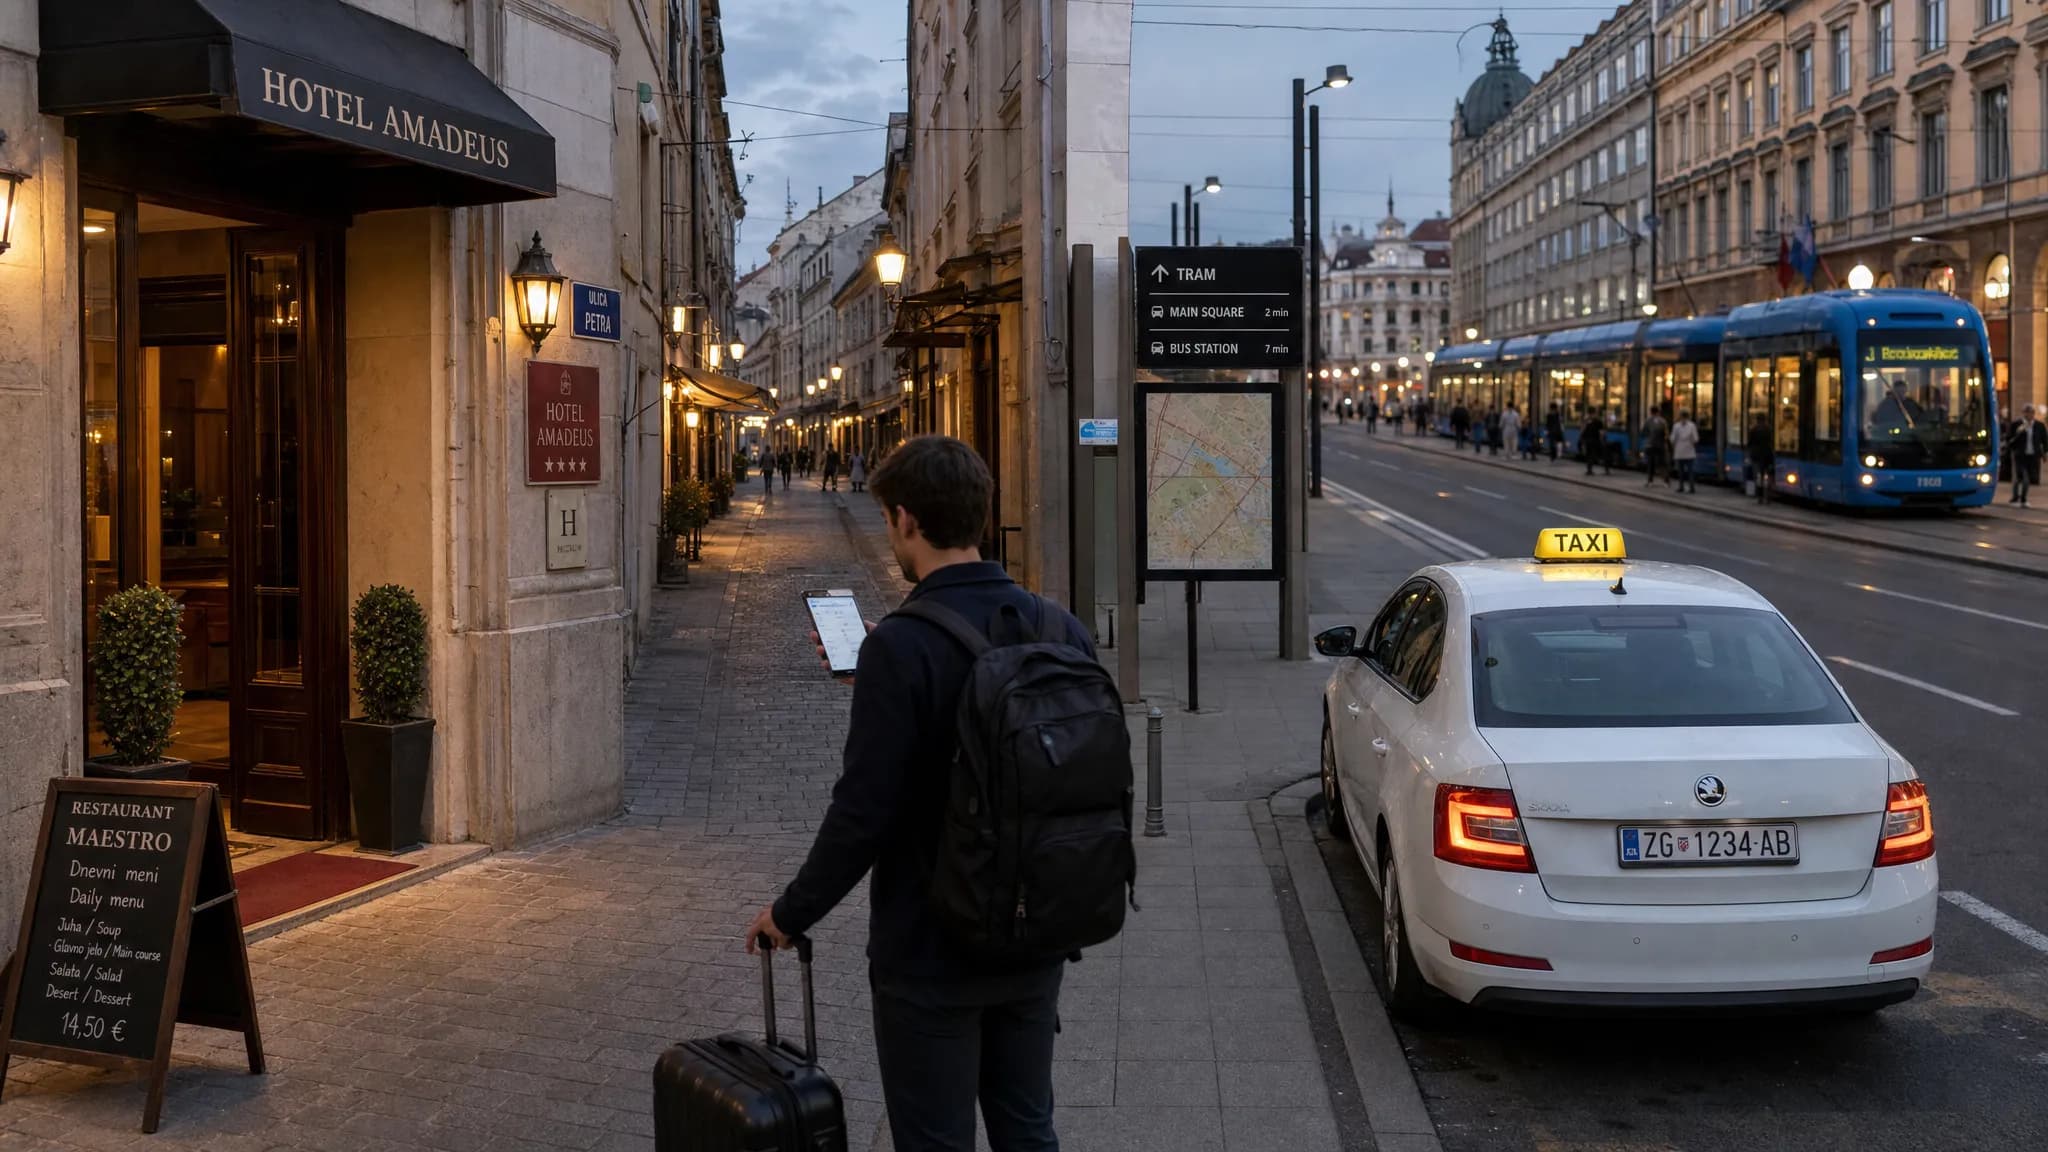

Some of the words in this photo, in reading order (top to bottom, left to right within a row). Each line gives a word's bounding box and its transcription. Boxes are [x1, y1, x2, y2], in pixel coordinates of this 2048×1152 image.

[262, 67, 373, 131] HOTEL
[382, 105, 509, 169] AMADEUS
[1176, 268, 1216, 281] TRAM
[588, 290, 608, 307] ULICA
[585, 312, 611, 333] PETRA
[1169, 306, 1198, 318] MAIN
[1201, 306, 1244, 319] SQUARE
[1264, 307, 1271, 317] 2
[1272, 307, 1289, 317] min
[1169, 343, 1191, 354] BUS
[1194, 343, 1238, 354] STATION
[1264, 344, 1271, 354] 7
[1272, 344, 1289, 354] min
[546, 402, 585, 423] HOTEL
[537, 427, 594, 447] AMADEUS
[560, 509, 577, 536] H
[1554, 533, 1608, 552] TAXI
[71, 801, 175, 820] RESTAURANT
[65, 827, 172, 852] MAESTRO
[1643, 832, 1674, 858] ZG
[70, 859, 117, 880] Dnevni
[125, 866, 159, 883] meni
[69, 887, 103, 912] Daily
[109, 895, 145, 909] menu
[57, 917, 82, 933] Juha
[84, 918, 95, 935] /
[96, 921, 122, 940] Soup
[53, 939, 85, 955] Glavno
[84, 942, 103, 960] jelo
[112, 944, 133, 959] Main
[134, 951, 161, 961] course
[83, 963, 95, 981] /
[94, 967, 123, 982] Salad
[46, 983, 79, 1001] Desert
[82, 985, 93, 1004] /
[94, 989, 132, 1006] Dessert
[62, 1011, 105, 1039] 14,50
[111, 1019, 127, 1042] €
